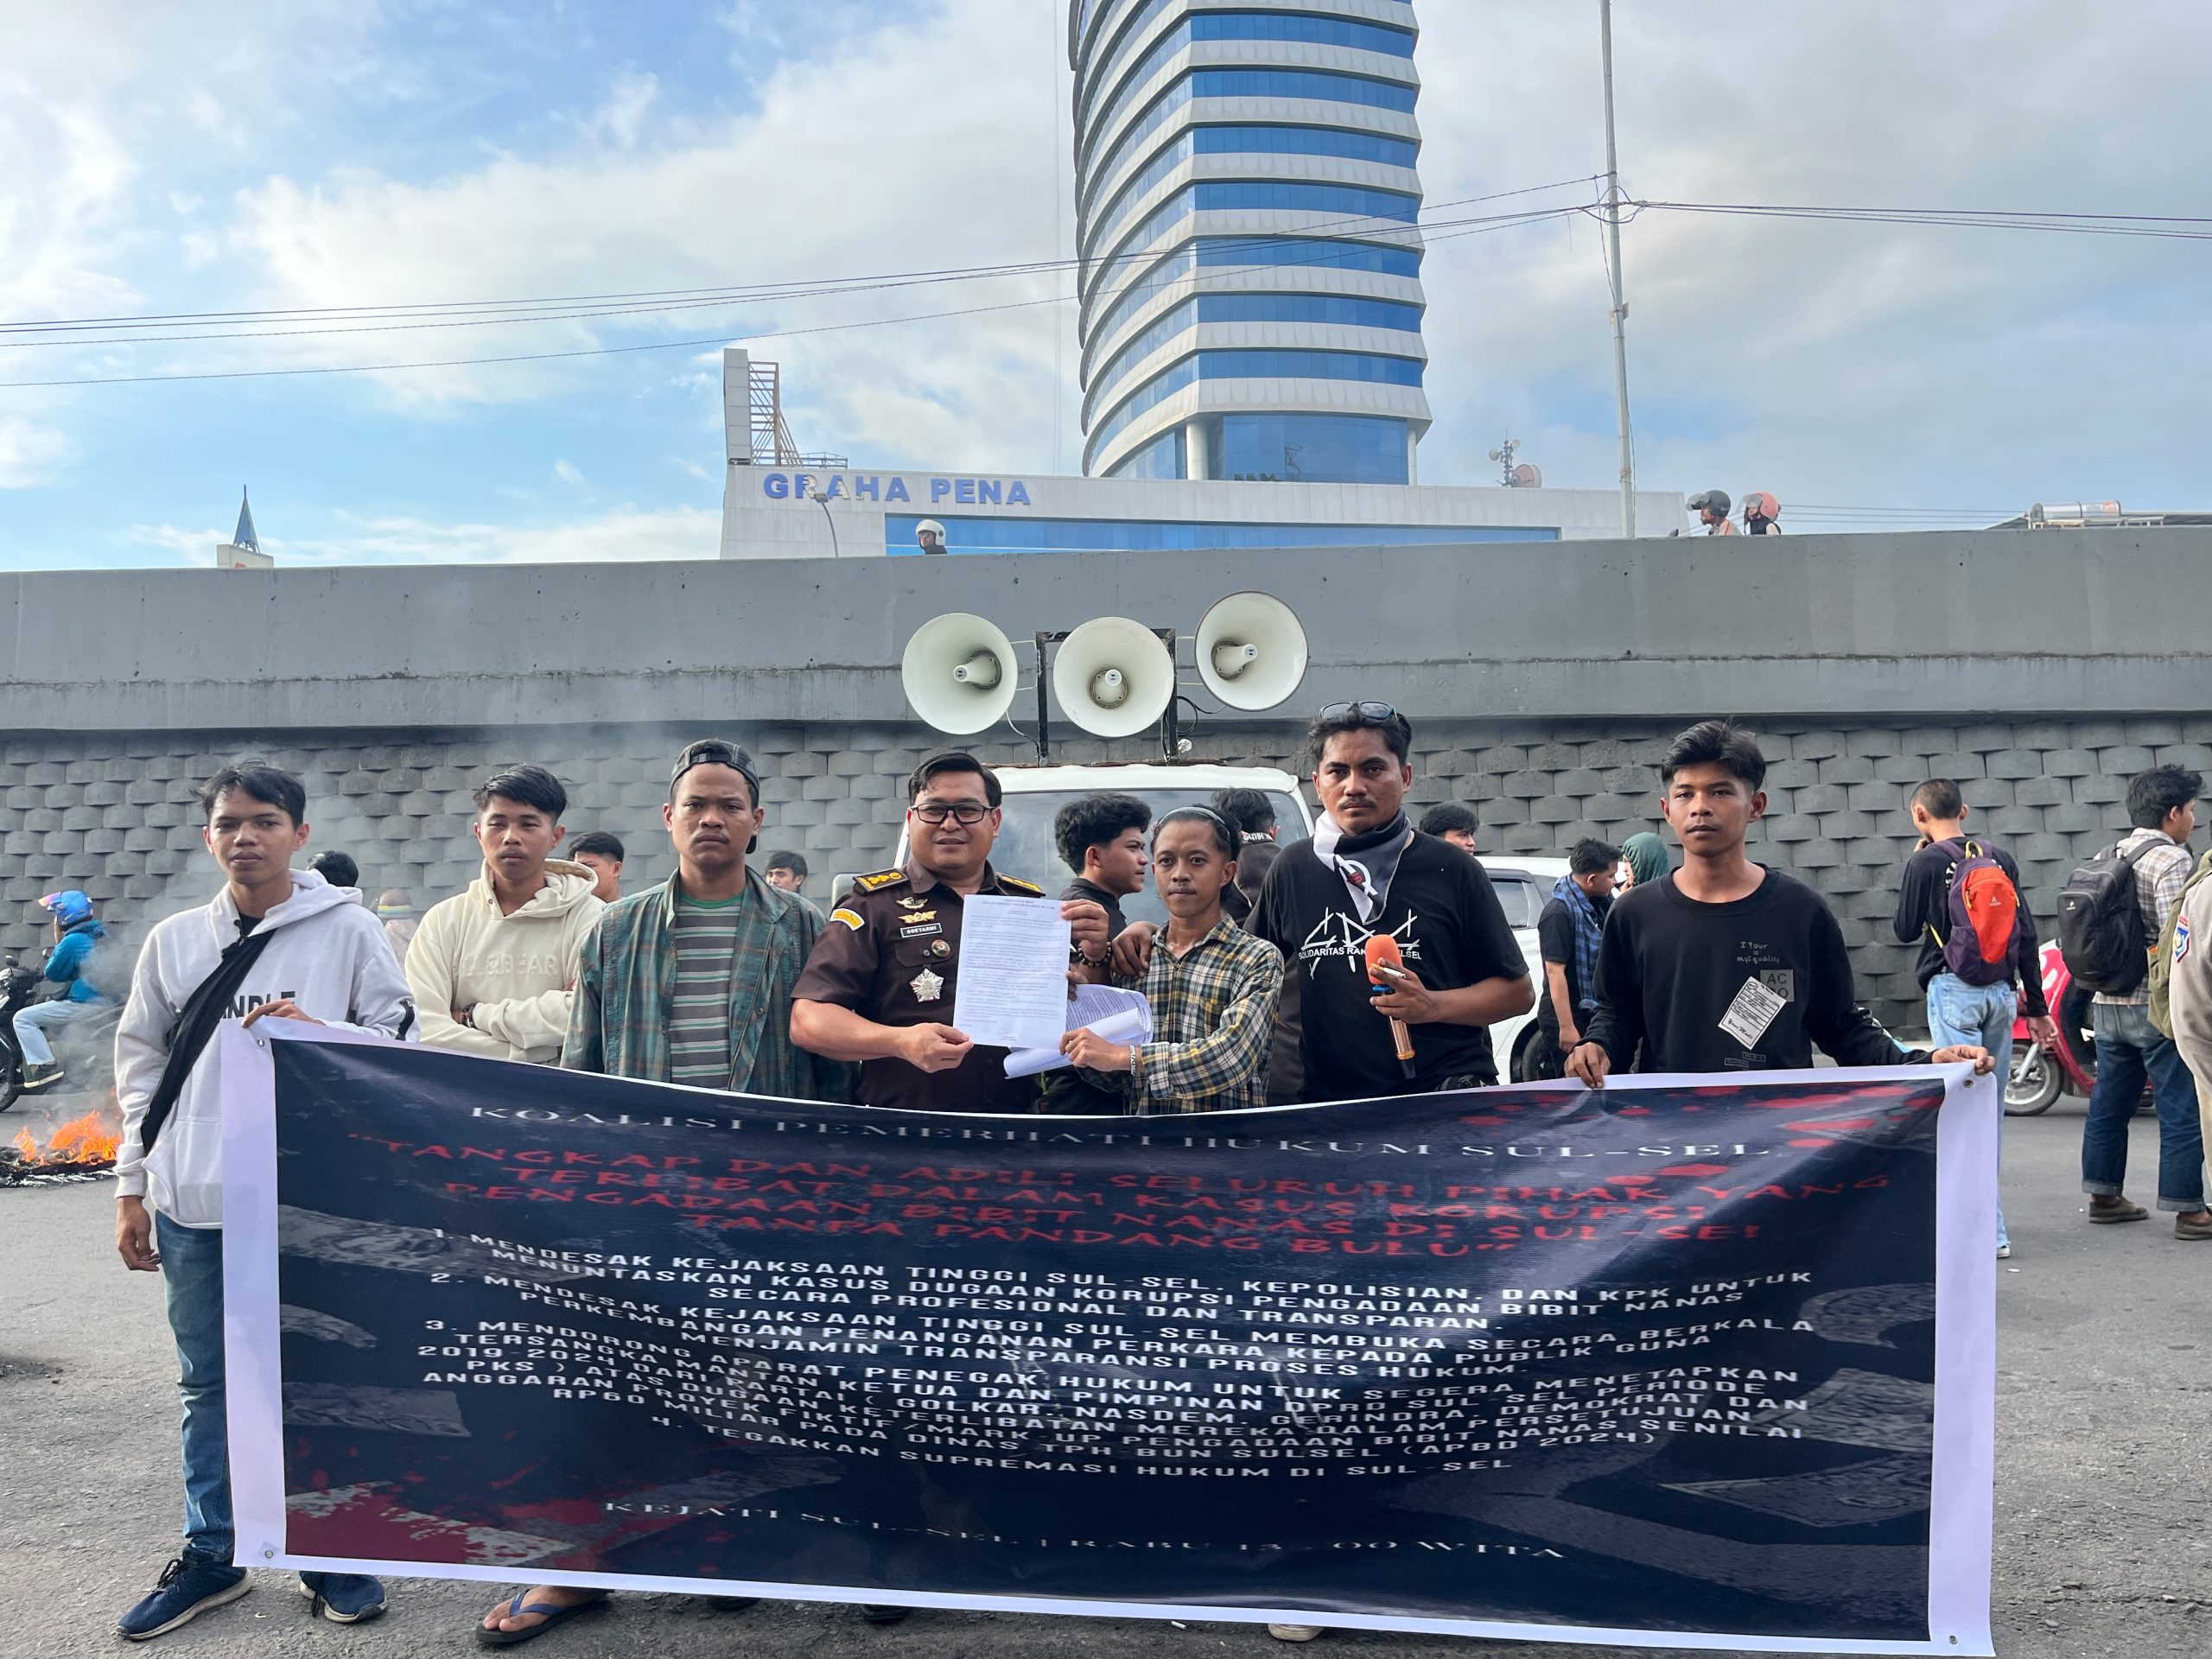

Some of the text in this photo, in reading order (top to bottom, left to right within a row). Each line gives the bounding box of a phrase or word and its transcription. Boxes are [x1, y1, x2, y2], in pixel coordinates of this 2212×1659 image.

[764, 473, 1031, 505] GRAHA PENA
[1298, 946, 1344, 960] SOLIDARITAS
[1767, 973, 1787, 984] AC
[471, 1107, 1769, 1157] KOALISI PEMERHATI HUKUM SUL-SEL
[729, 1159, 870, 1177] DAN
[1445, 1185, 1669, 1201] PIHAK
[1695, 1174, 1889, 1199] YANG
[869, 1184, 1103, 1205] DALAM
[1135, 1194, 1357, 1216] KASUS
[1389, 1204, 1706, 1220] KORUPSI
[444, 1183, 871, 1214] PENGADAAN
[1111, 1211, 1353, 1234] NANAS
[1384, 1222, 1454, 1238] DI
[678, 1214, 906, 1236] TANPA
[934, 1224, 1260, 1249] PANDANG
[432, 1228, 454, 1239] 1.
[470, 1234, 652, 1267] MENDESAK
[672, 1257, 884, 1275] KEJAKSAAN
[906, 1267, 1027, 1282] TINGGI
[1503, 1289, 1578, 1301] DAN
[1599, 1287, 1670, 1301] KPK
[1691, 1272, 1811, 1294] UNTUK
[492, 1249, 1744, 1315] MENUNTASKAN KASUS DUGAAN KORUPSI PENGADAAN BIBIT NANAS
[430, 1273, 1814, 1350] 2. MENDESAK KEJAKSAAN TINGGI SUL-SEL MEMBUKA SECARA BERKALA
[520, 1292, 1711, 1363] PERKEMBANGAN PENANGANAN PERKARA KEPADA PUBLIK GUNA
[709, 1287, 1503, 1330] SECARA PROFESIONAL DAN TRANSPARAN.
[424, 1319, 1798, 1400] 3. MENDORONG APARAT PENEGAK HUKUM UNTUK SEGERA MENETAPKAN
[454, 1333, 1765, 1413] TERSANGKA MANTAN KETUA DAN PIMPINAN DPRD SUL-SEL PERIODE
[680, 1332, 1528, 1377] MENJAMIN TRANSPARANSI PROSES HUKUM.
[423, 1372, 613, 1389] ANGGARAN
[632, 1383, 760, 1412] PROYEK
[1122, 1436, 1353, 1446] PENGADAAN
[1374, 1432, 1474, 1445] BIBIT
[1497, 1420, 1618, 1438] NANAS
[1640, 1419, 1802, 1440] SENILAI
[467, 1360, 534, 1372] PKS
[587, 1366, 664, 1386] ATAS
[682, 1382, 818, 1409] DUGAAN
[839, 1404, 1116, 1433] KETERLIBATAN
[1137, 1424, 1294, 1436] MEREKA
[1316, 1422, 1446, 1435] DALAM
[1469, 1406, 1751, 1428] PERSETUJUAN
[633, 1363, 708, 1382] DARI
[726, 1376, 845, 1402] PARTAI
[1501, 1392, 1704, 1415] DEMOKRAT
[1729, 1396, 1808, 1411] DAN
[652, 1416, 1513, 1477] 4. TEGAKKAN SUPREMASI HUKUM DI SUL-SEL
[664, 1400, 779, 1426] MILIAR
[800, 1421, 888, 1440] PADA
[907, 1433, 1020, 1451] DINAS
[1231, 1448, 1381, 1459] SULSEL
